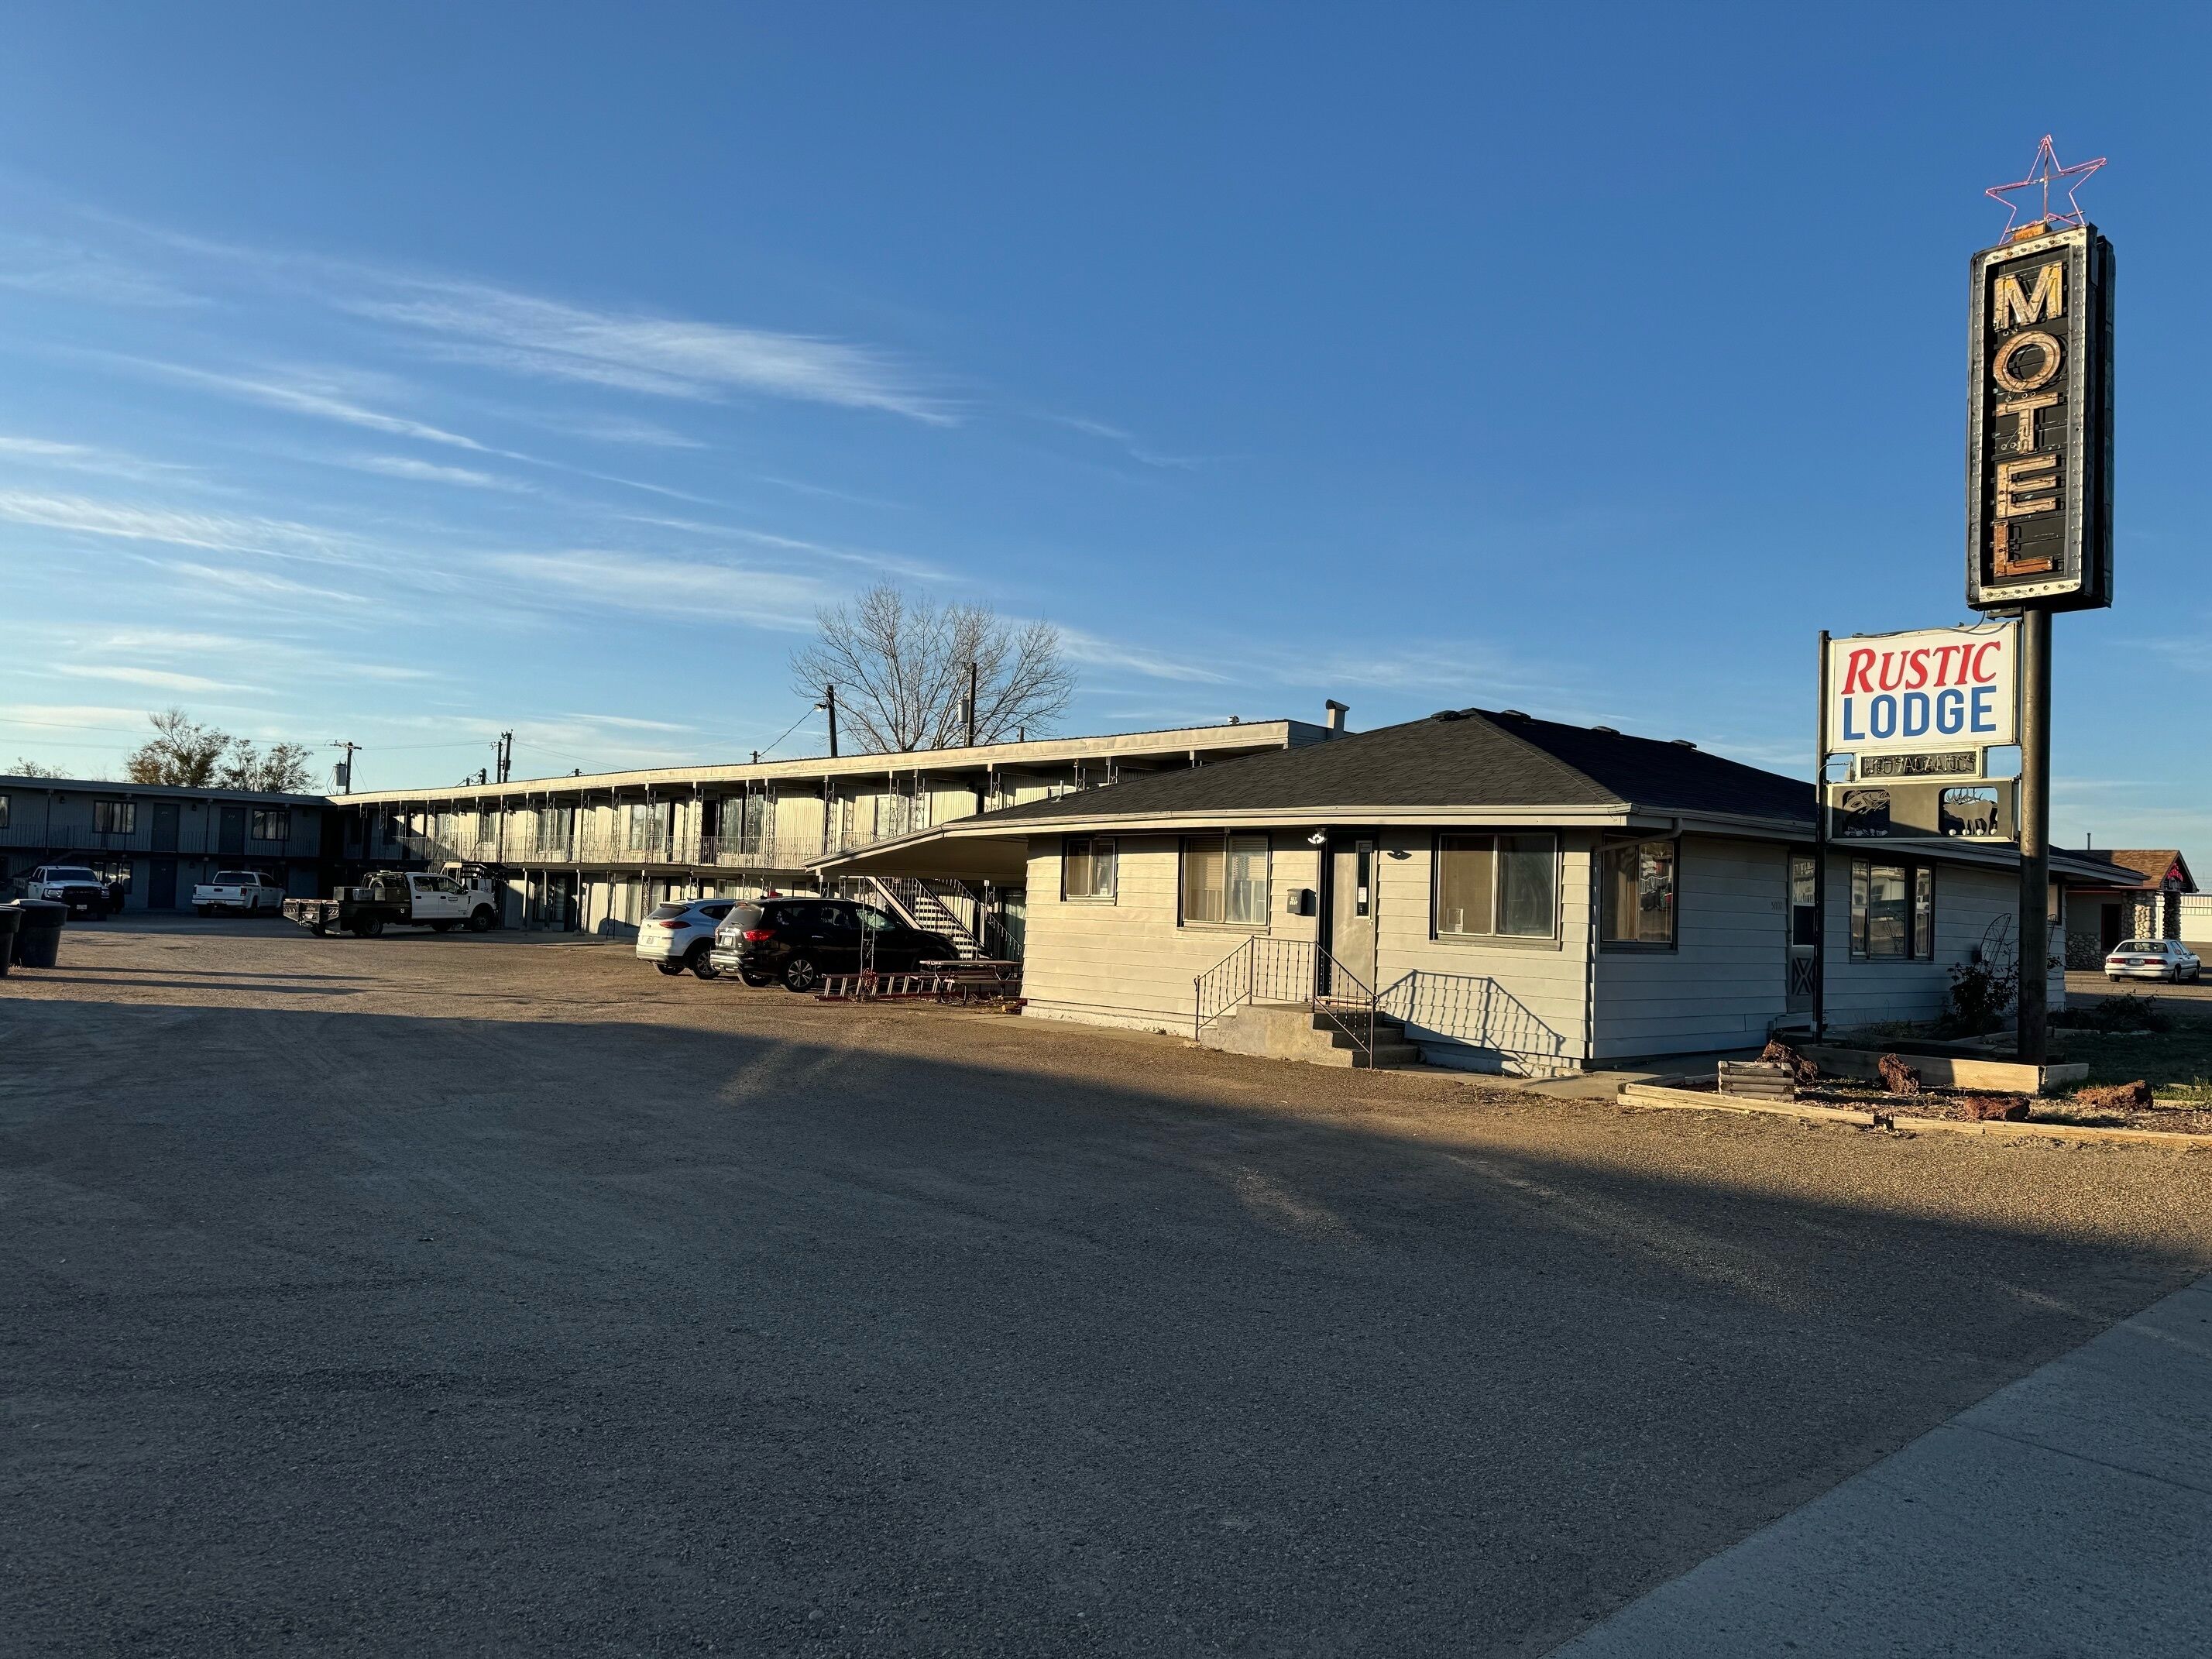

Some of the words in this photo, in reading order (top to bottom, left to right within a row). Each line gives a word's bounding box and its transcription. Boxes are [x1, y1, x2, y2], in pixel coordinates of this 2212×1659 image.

[1993, 261, 2063, 577] MOTEL
[1841, 641, 2001, 695] RUSTIC
[1843, 685, 1997, 740] LODGE
